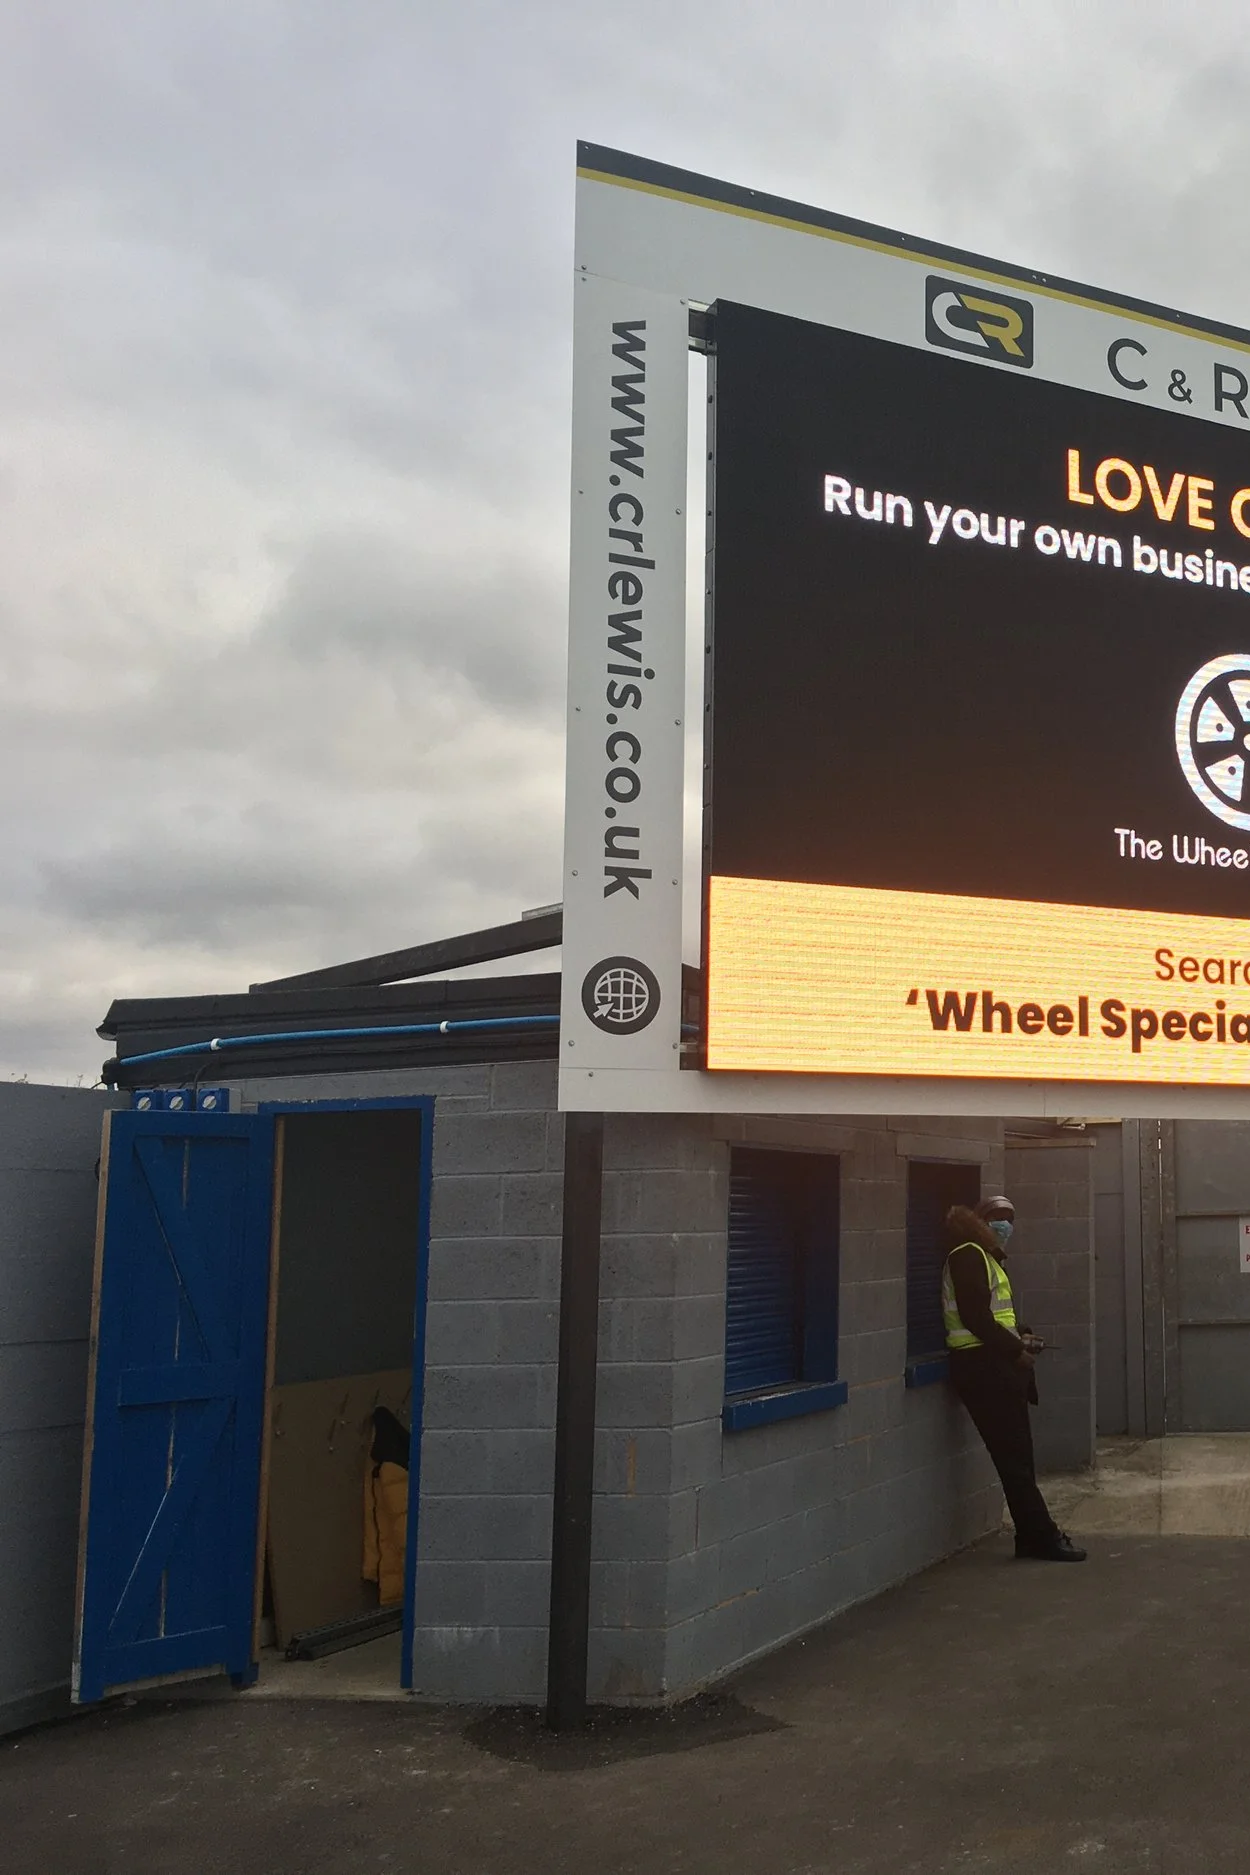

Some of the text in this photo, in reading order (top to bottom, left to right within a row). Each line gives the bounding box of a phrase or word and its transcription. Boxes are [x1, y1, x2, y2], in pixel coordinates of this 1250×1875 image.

[1107, 338, 1148, 391] C
[1167, 369, 1193, 405] &
[1213, 362, 1250, 419] R
[823, 474, 914, 528] Run
[923, 500, 1026, 545] your
[1034, 524, 1122, 568] own
[1067, 448, 1216, 531] LOVE
[604, 319, 656, 899] www.crlewis.co.uk
[1114, 827, 1163, 861] The
